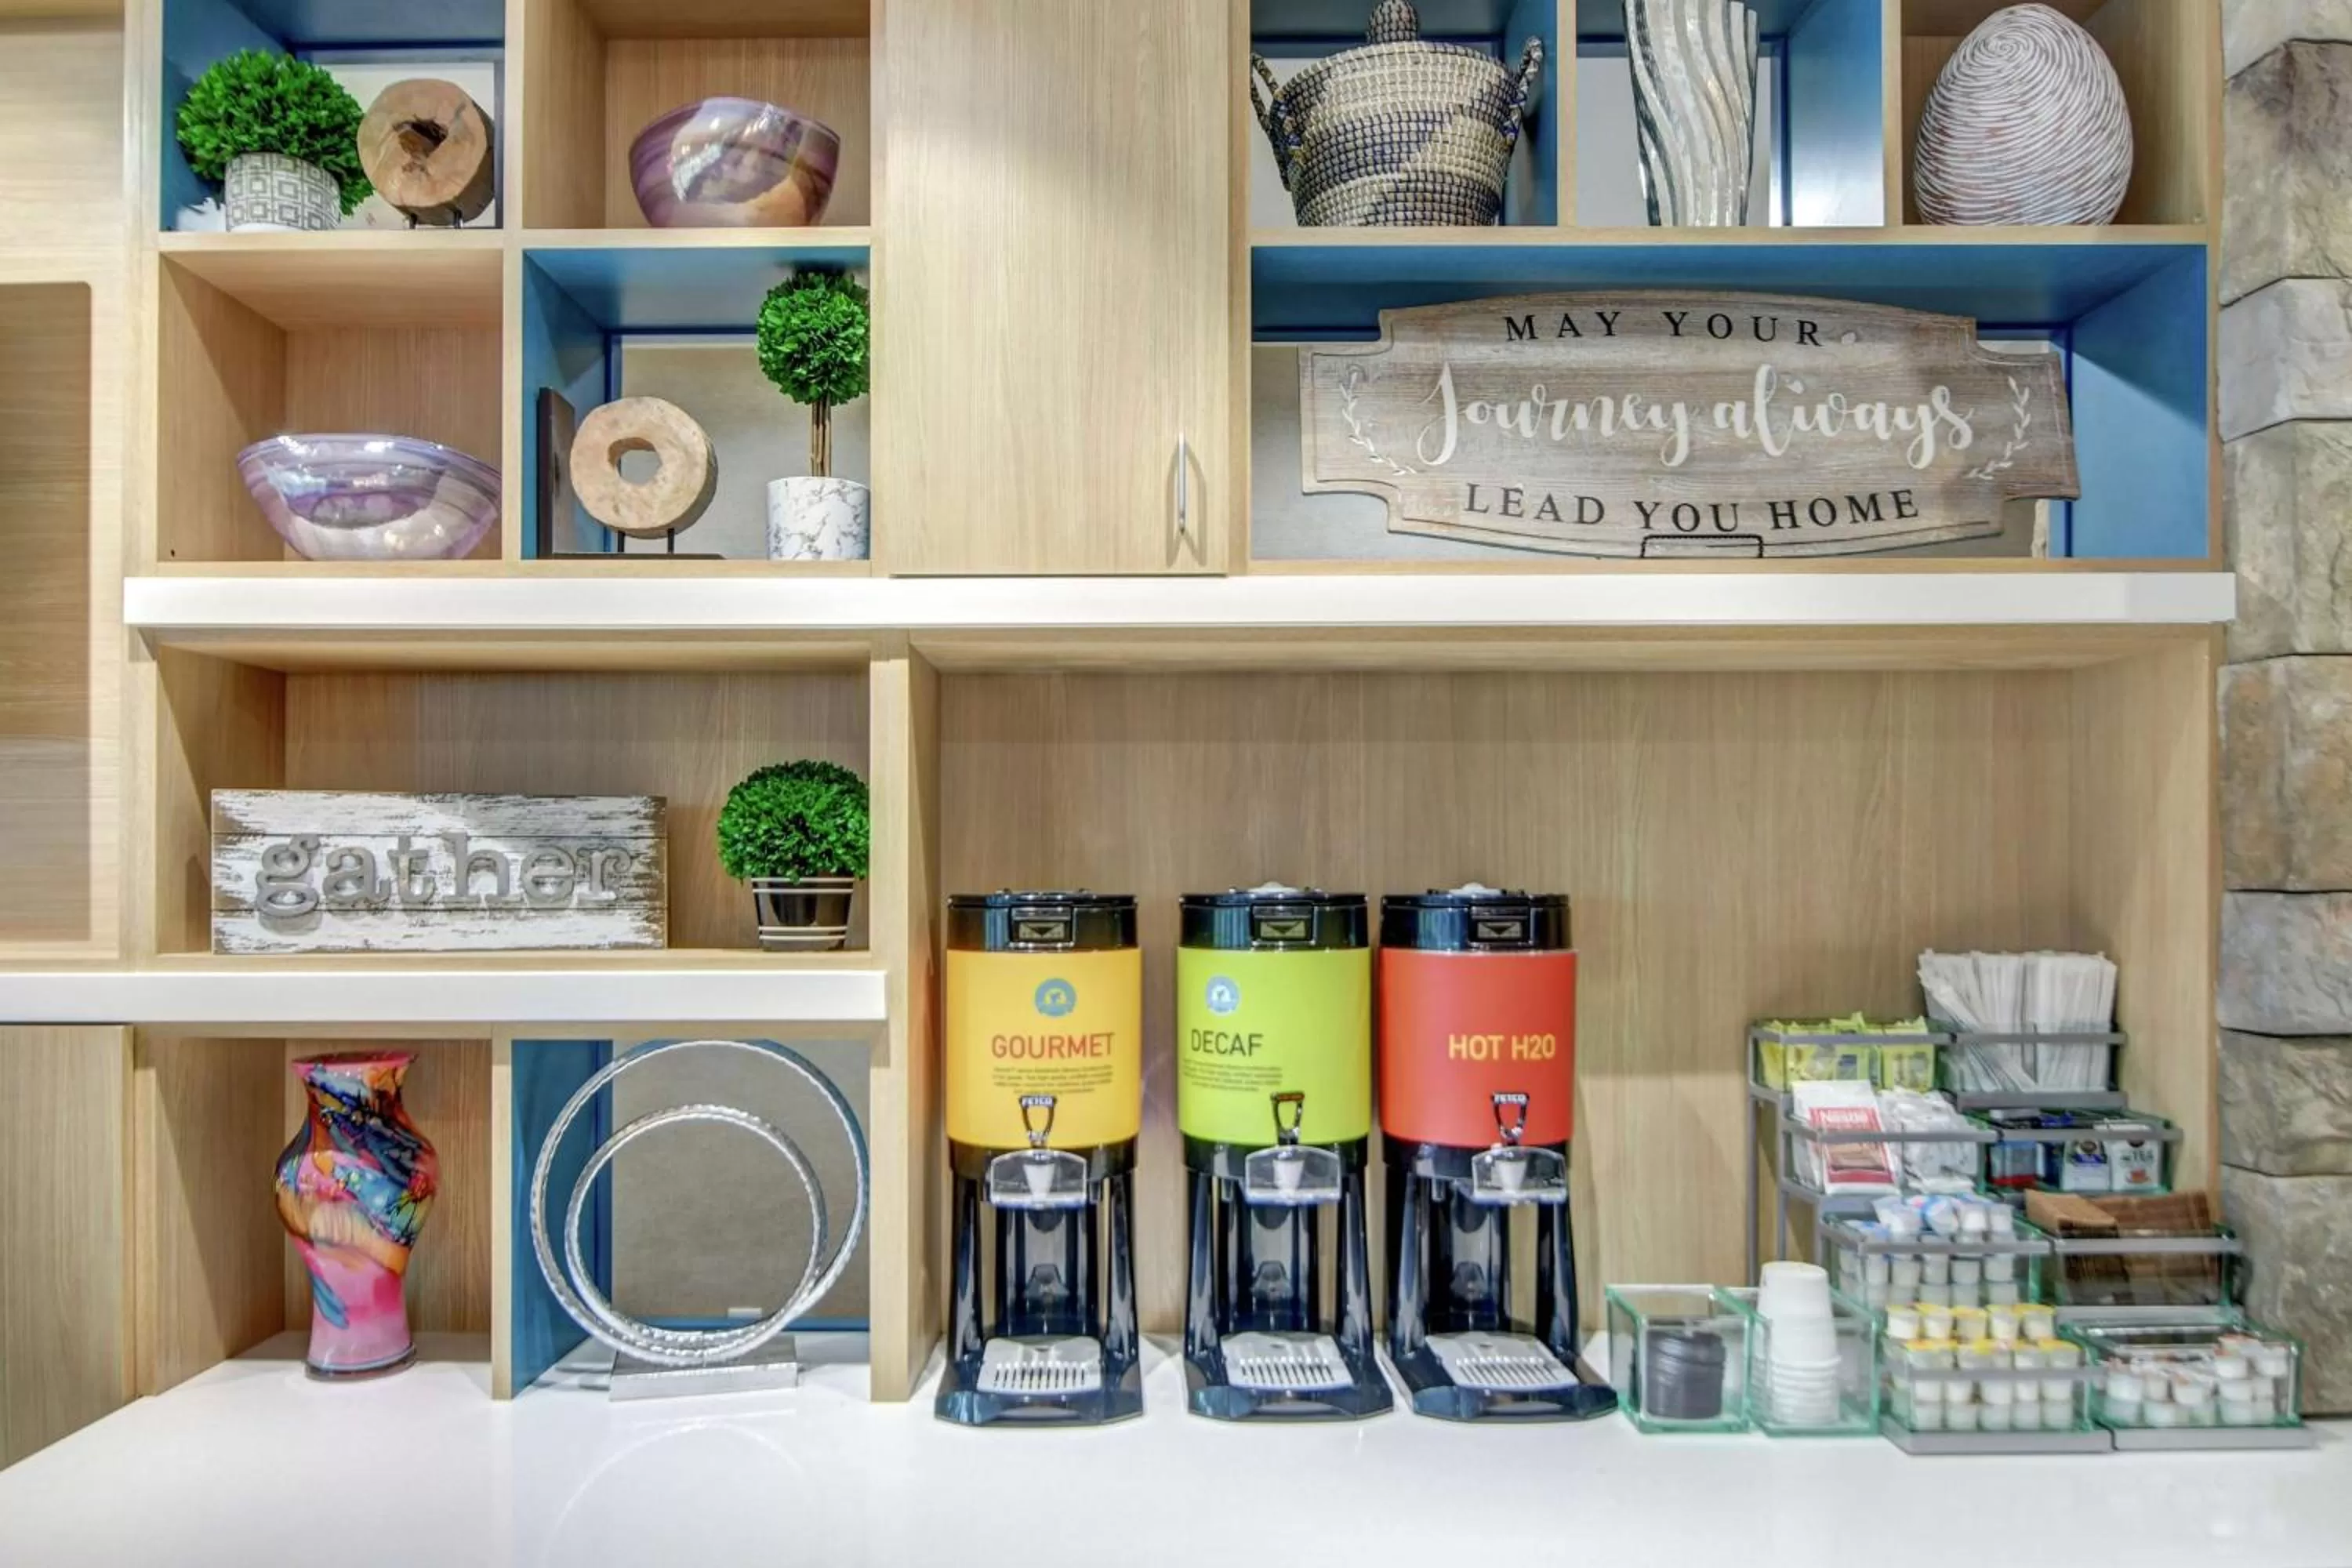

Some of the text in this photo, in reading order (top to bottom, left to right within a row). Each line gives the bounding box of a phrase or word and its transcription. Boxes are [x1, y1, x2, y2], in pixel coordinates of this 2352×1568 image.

[1504, 310, 1822, 347] MAY YOUR
[1417, 361, 1973, 469] Journey always
[1464, 482, 1919, 533] LEAD YOU HOME
[256, 832, 633, 920] gather
[991, 1032, 1115, 1059] GOURMET
[1191, 1029, 1263, 1057] DECAF
[1448, 1034, 1504, 1060] HOT
